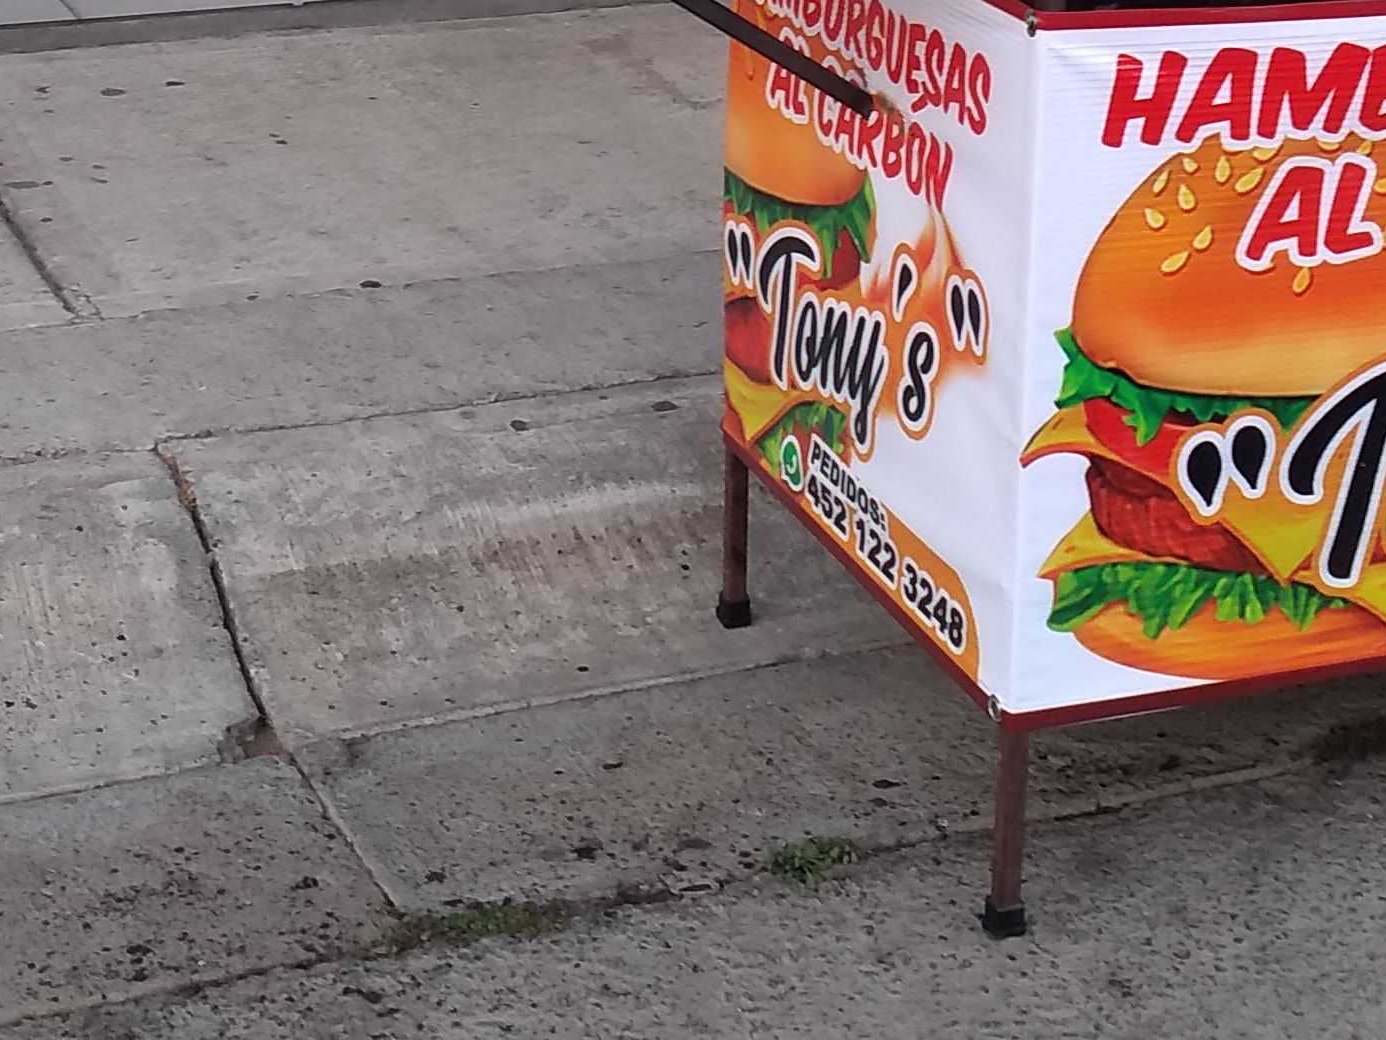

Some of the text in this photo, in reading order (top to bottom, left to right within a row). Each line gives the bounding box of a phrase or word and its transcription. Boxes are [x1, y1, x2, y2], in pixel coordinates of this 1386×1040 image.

[1246, 162, 1374, 260] AL
[811, 440, 886, 532] PEDIDOS:
[807, 474, 963, 648] 452 122 3248
